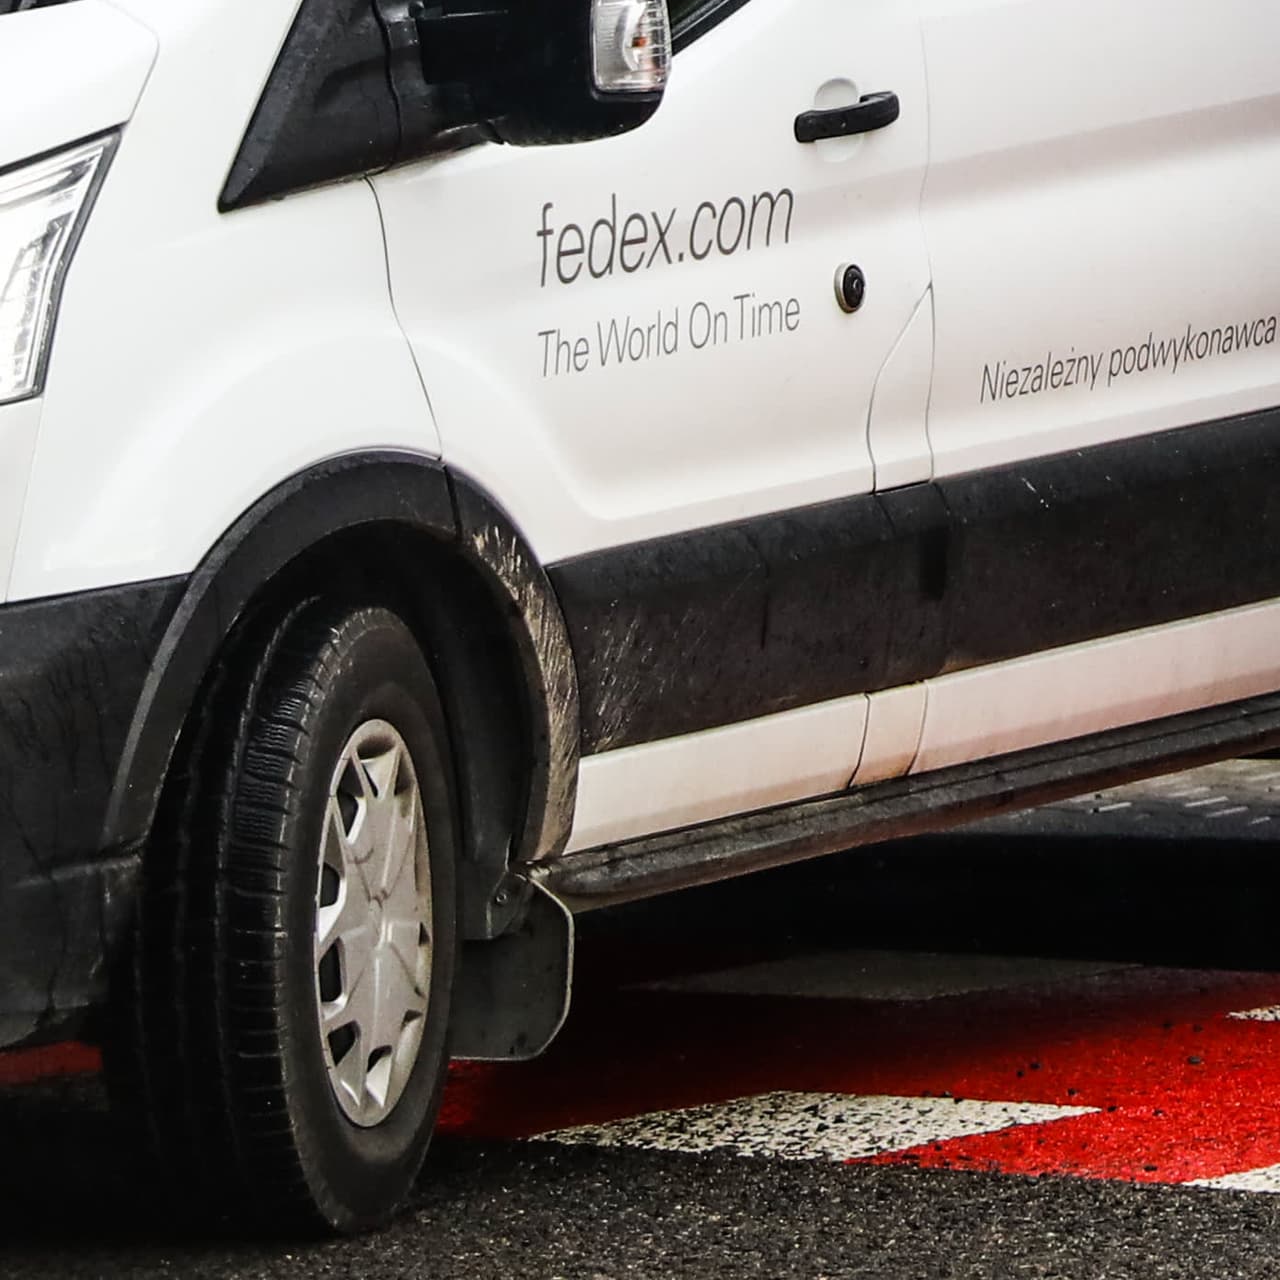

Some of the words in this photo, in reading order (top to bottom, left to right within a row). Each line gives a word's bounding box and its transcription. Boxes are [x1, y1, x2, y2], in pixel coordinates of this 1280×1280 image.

[536, 187, 794, 287] fedex.com
[538, 328, 589, 377] The
[597, 306, 679, 366] World
[689, 301, 728, 349] On
[733, 292, 800, 340] Time
[980, 346, 1103, 403] Niezależny
[1108, 315, 1277, 387] podwykonawca
